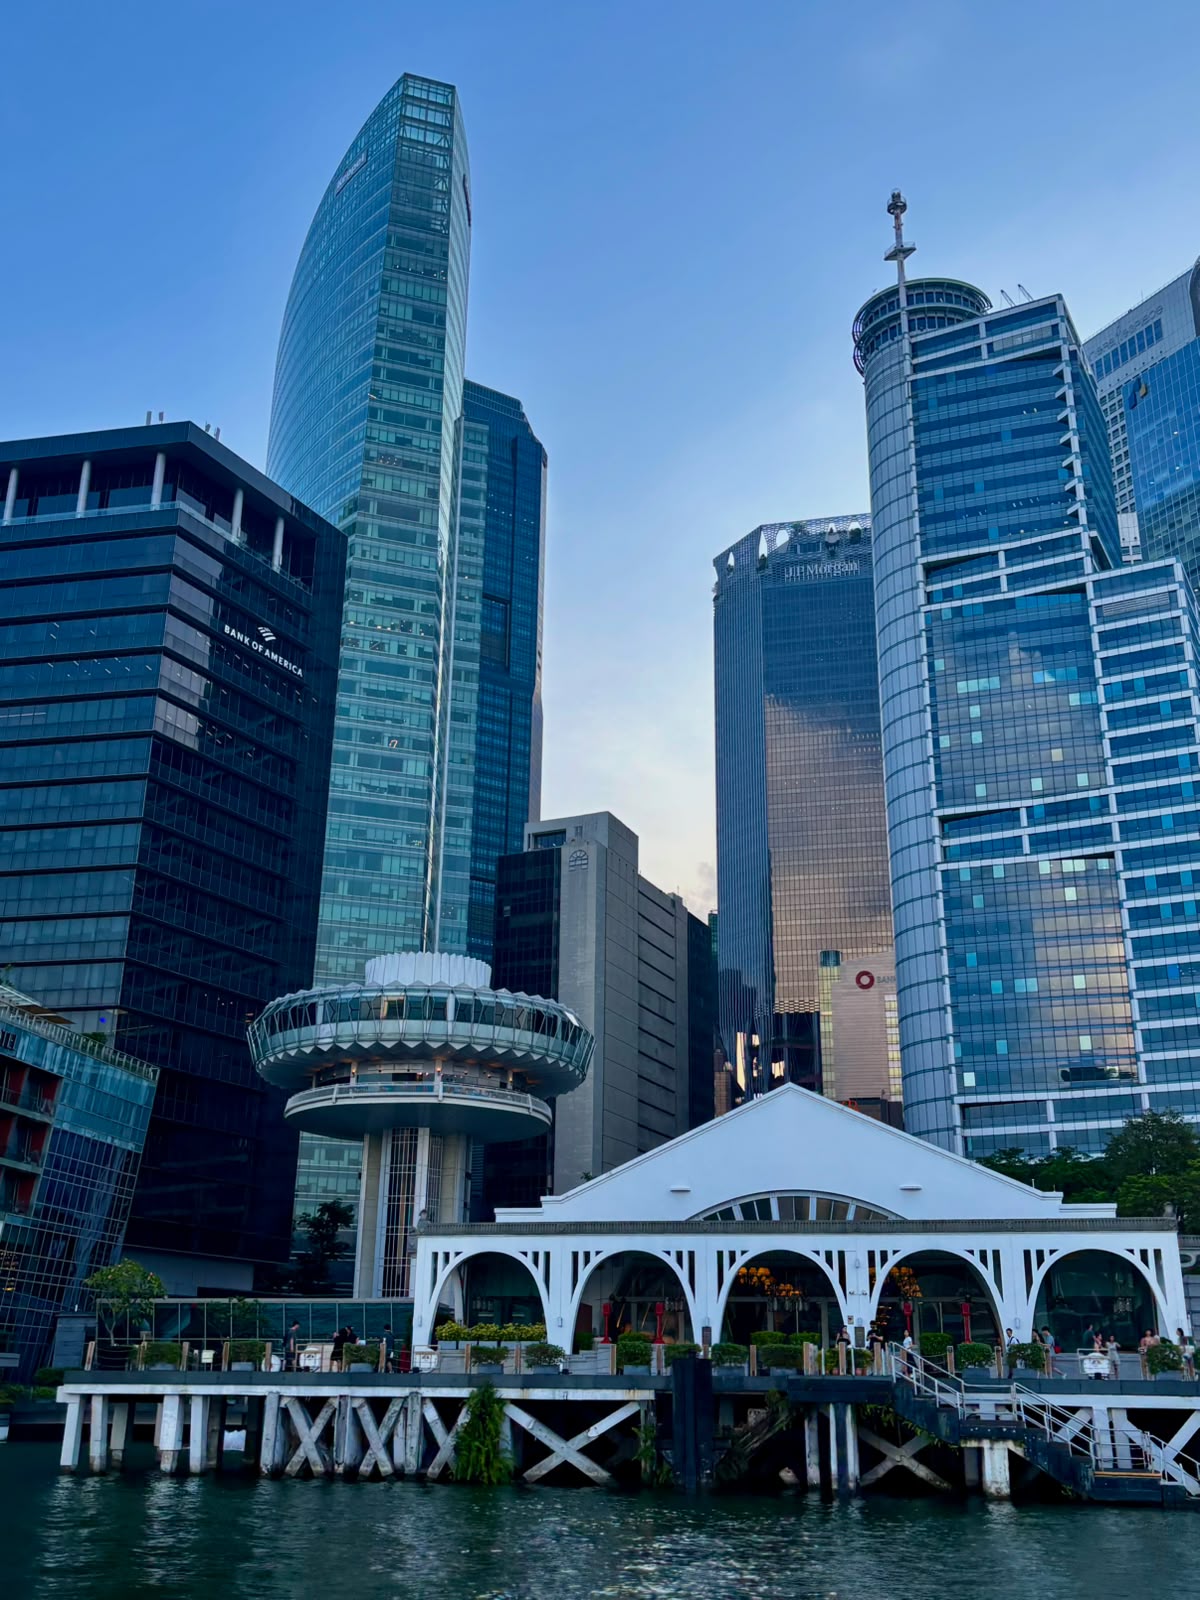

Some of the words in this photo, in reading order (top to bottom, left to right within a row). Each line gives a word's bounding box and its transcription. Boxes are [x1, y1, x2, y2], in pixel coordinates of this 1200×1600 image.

[224, 625, 250, 646] BANK
[251, 641, 264, 653] OF
[265, 649, 303, 678] AMERICA
